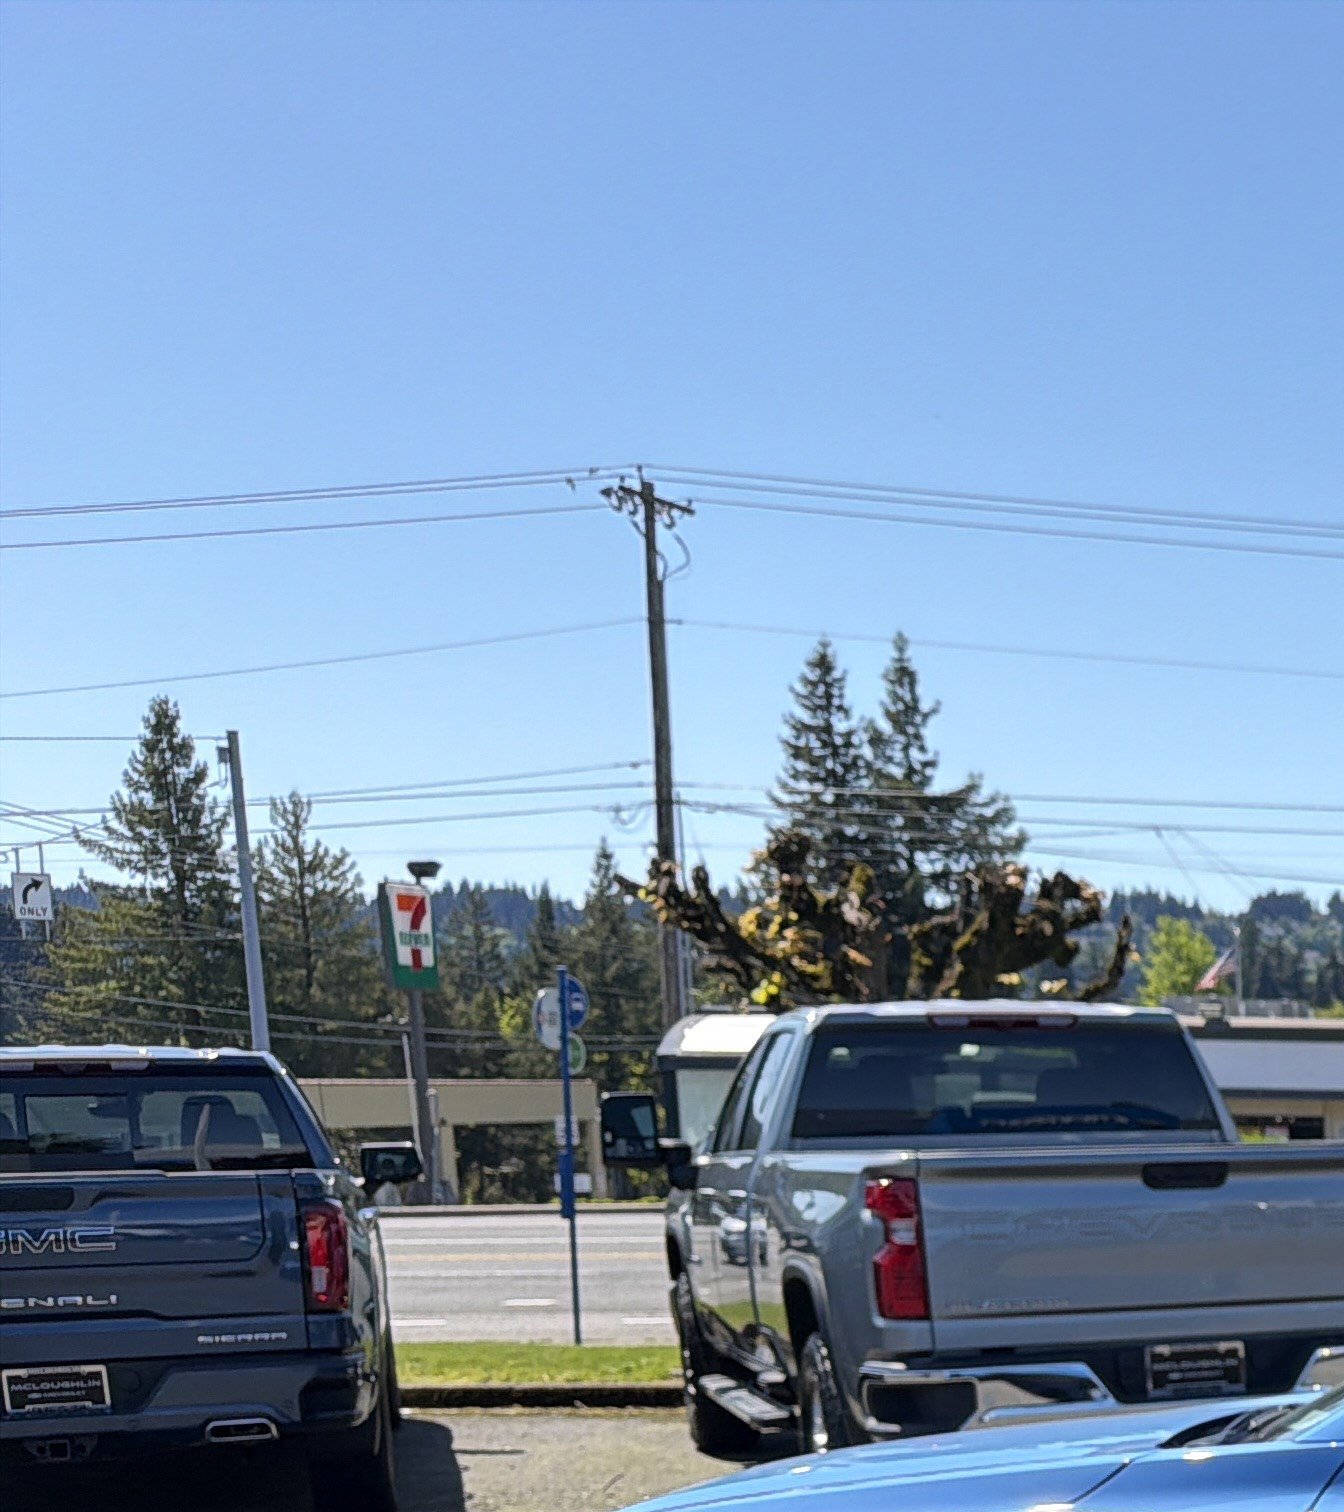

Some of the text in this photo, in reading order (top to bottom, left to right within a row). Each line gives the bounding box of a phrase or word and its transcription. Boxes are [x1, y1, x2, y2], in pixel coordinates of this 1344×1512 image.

[20, 907, 48, 916] ONLY
[0, 1226, 116, 1255] MC
[0, 1294, 118, 1309] ENALI
